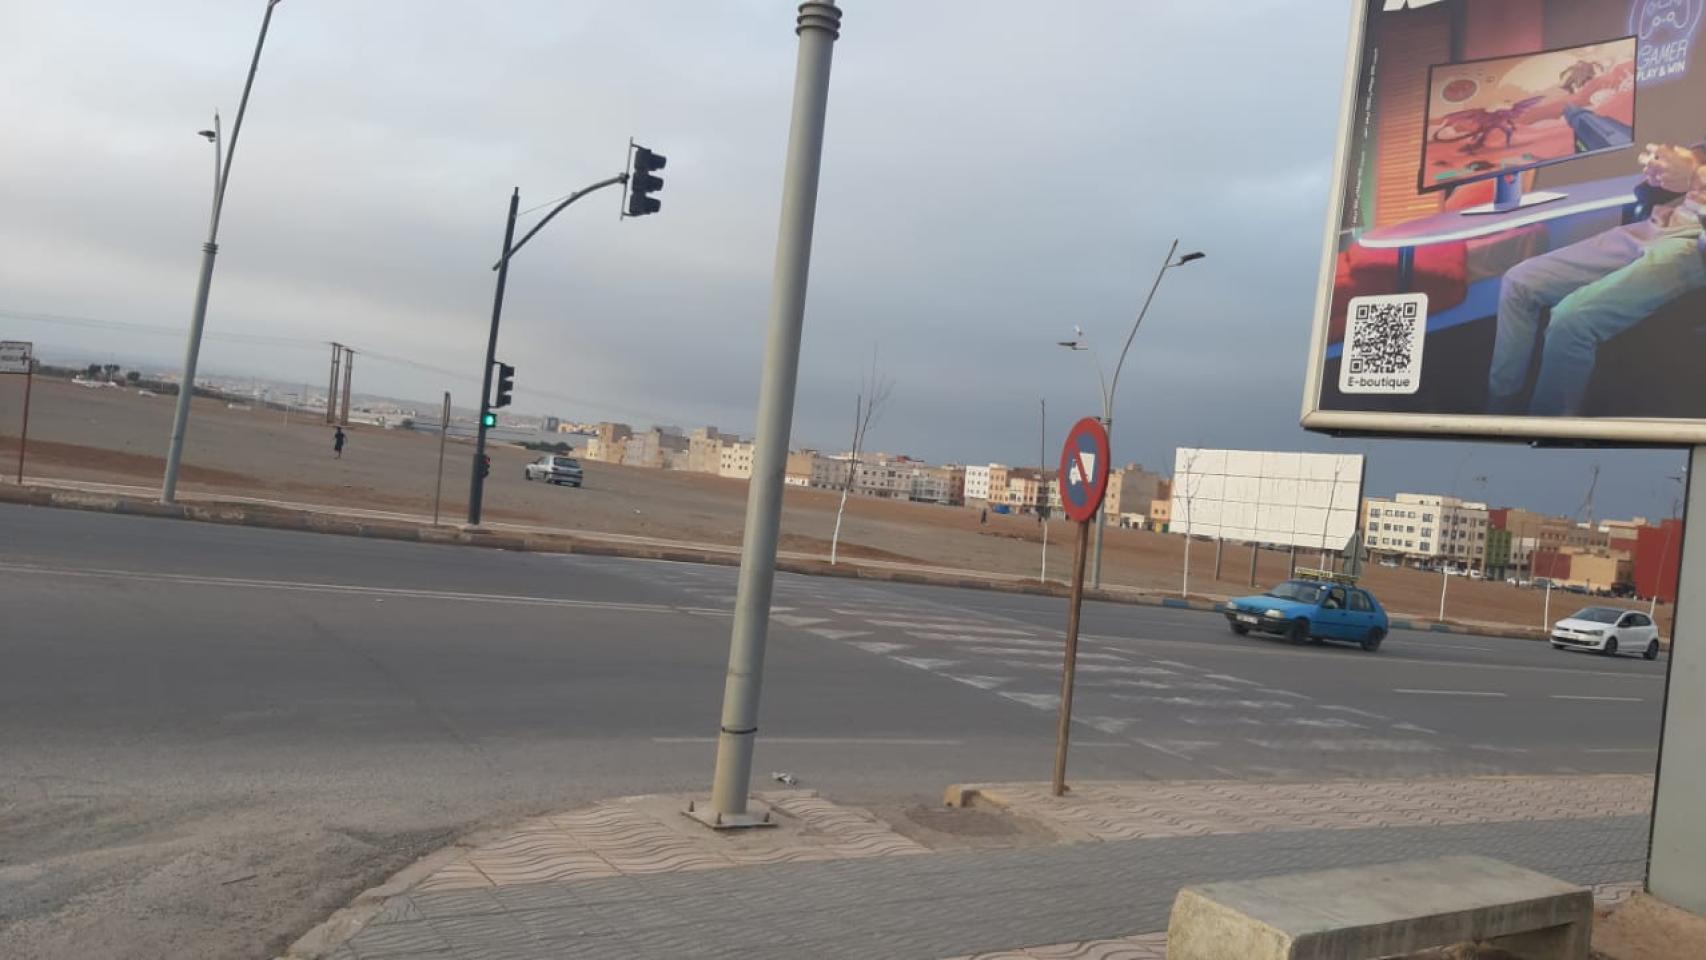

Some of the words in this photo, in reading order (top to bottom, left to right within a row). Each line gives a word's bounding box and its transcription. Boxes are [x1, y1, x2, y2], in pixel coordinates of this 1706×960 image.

[1641, 39, 1688, 66] GAMER
[1659, 65, 1667, 77] &
[1667, 62, 1685, 73] WIN
[1347, 376, 1410, 390] E-boutique
